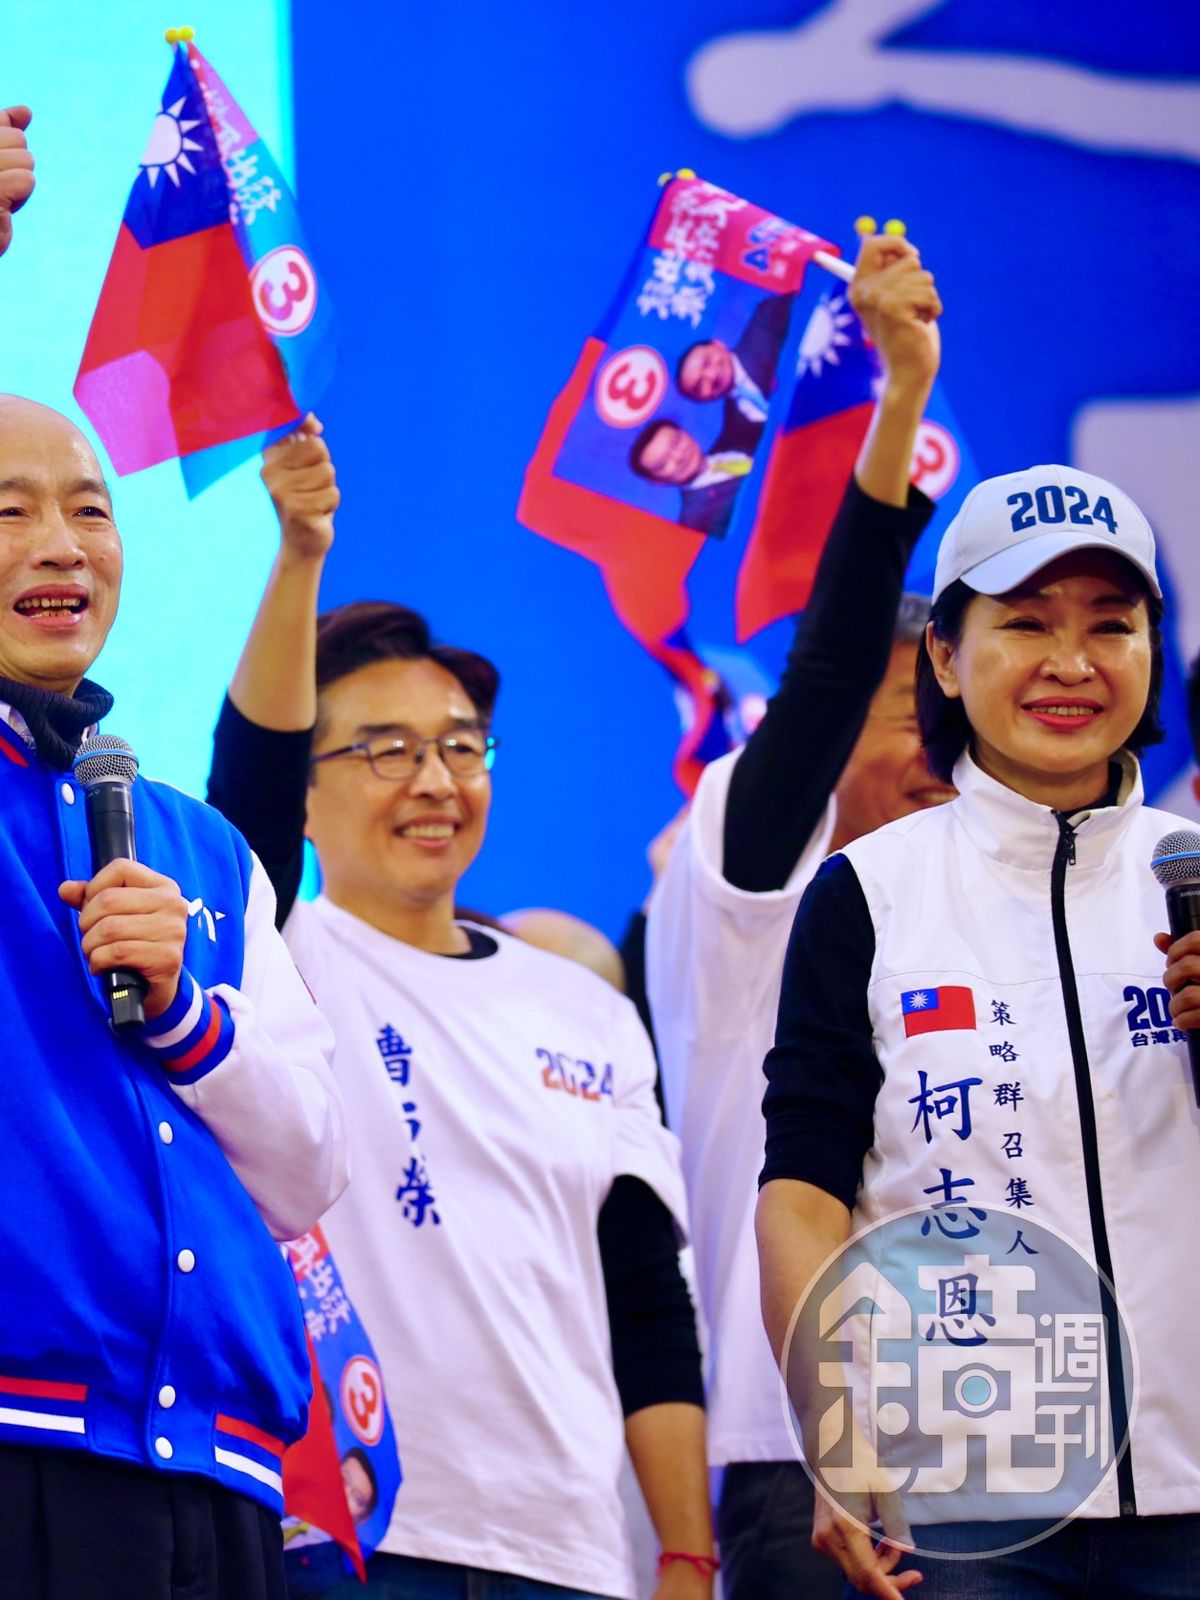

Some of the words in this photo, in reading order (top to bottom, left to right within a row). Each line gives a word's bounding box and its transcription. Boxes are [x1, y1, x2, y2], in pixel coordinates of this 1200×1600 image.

[1006, 484, 1119, 536] 2024
[1122, 985, 1174, 1032] 20
[1131, 1030, 1189, 1048] 台灣再
[988, 998, 1039, 1257] 策略群召集人
[907, 1069, 998, 1348] 柯志恩
